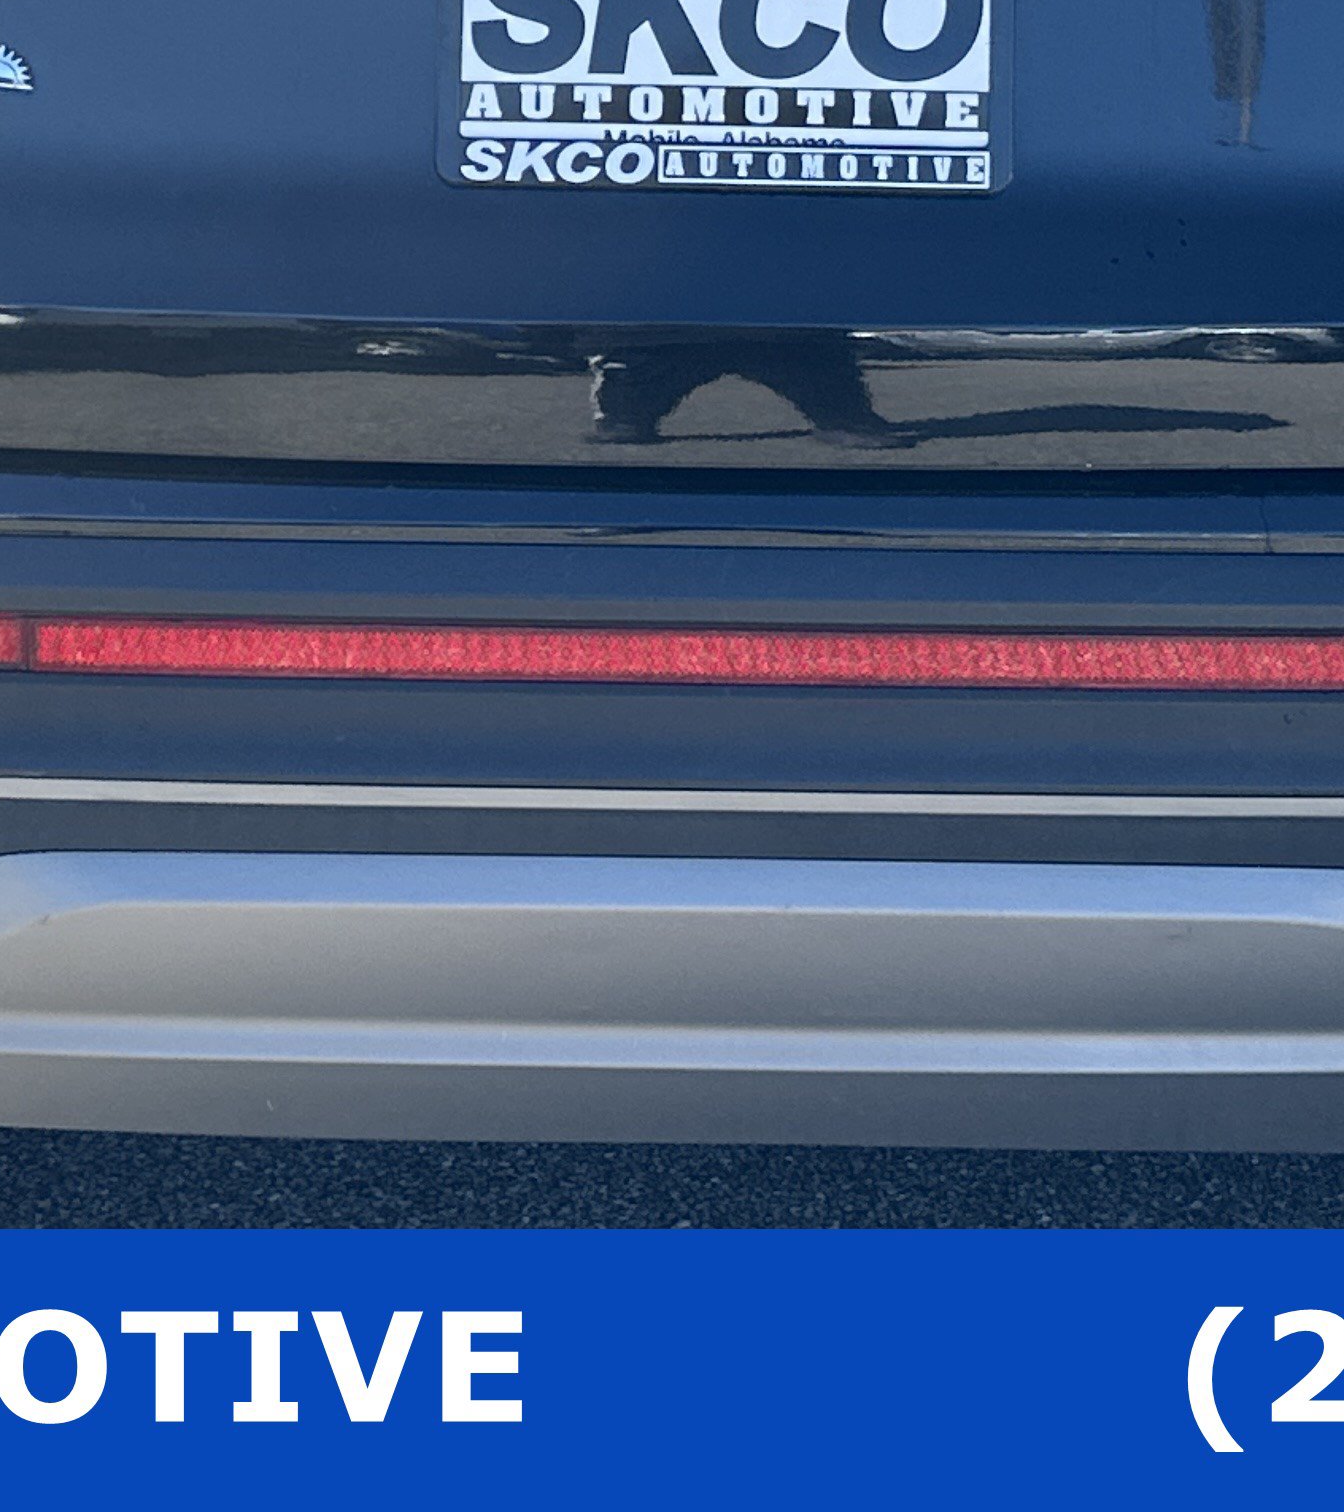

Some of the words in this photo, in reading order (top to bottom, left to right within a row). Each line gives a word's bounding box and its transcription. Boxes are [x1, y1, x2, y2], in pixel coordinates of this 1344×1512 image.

[464, 84, 981, 130] AUTOMOTIVE
[459, 139, 655, 184] SKCO
[663, 149, 986, 183] AUTOMOTIVE
